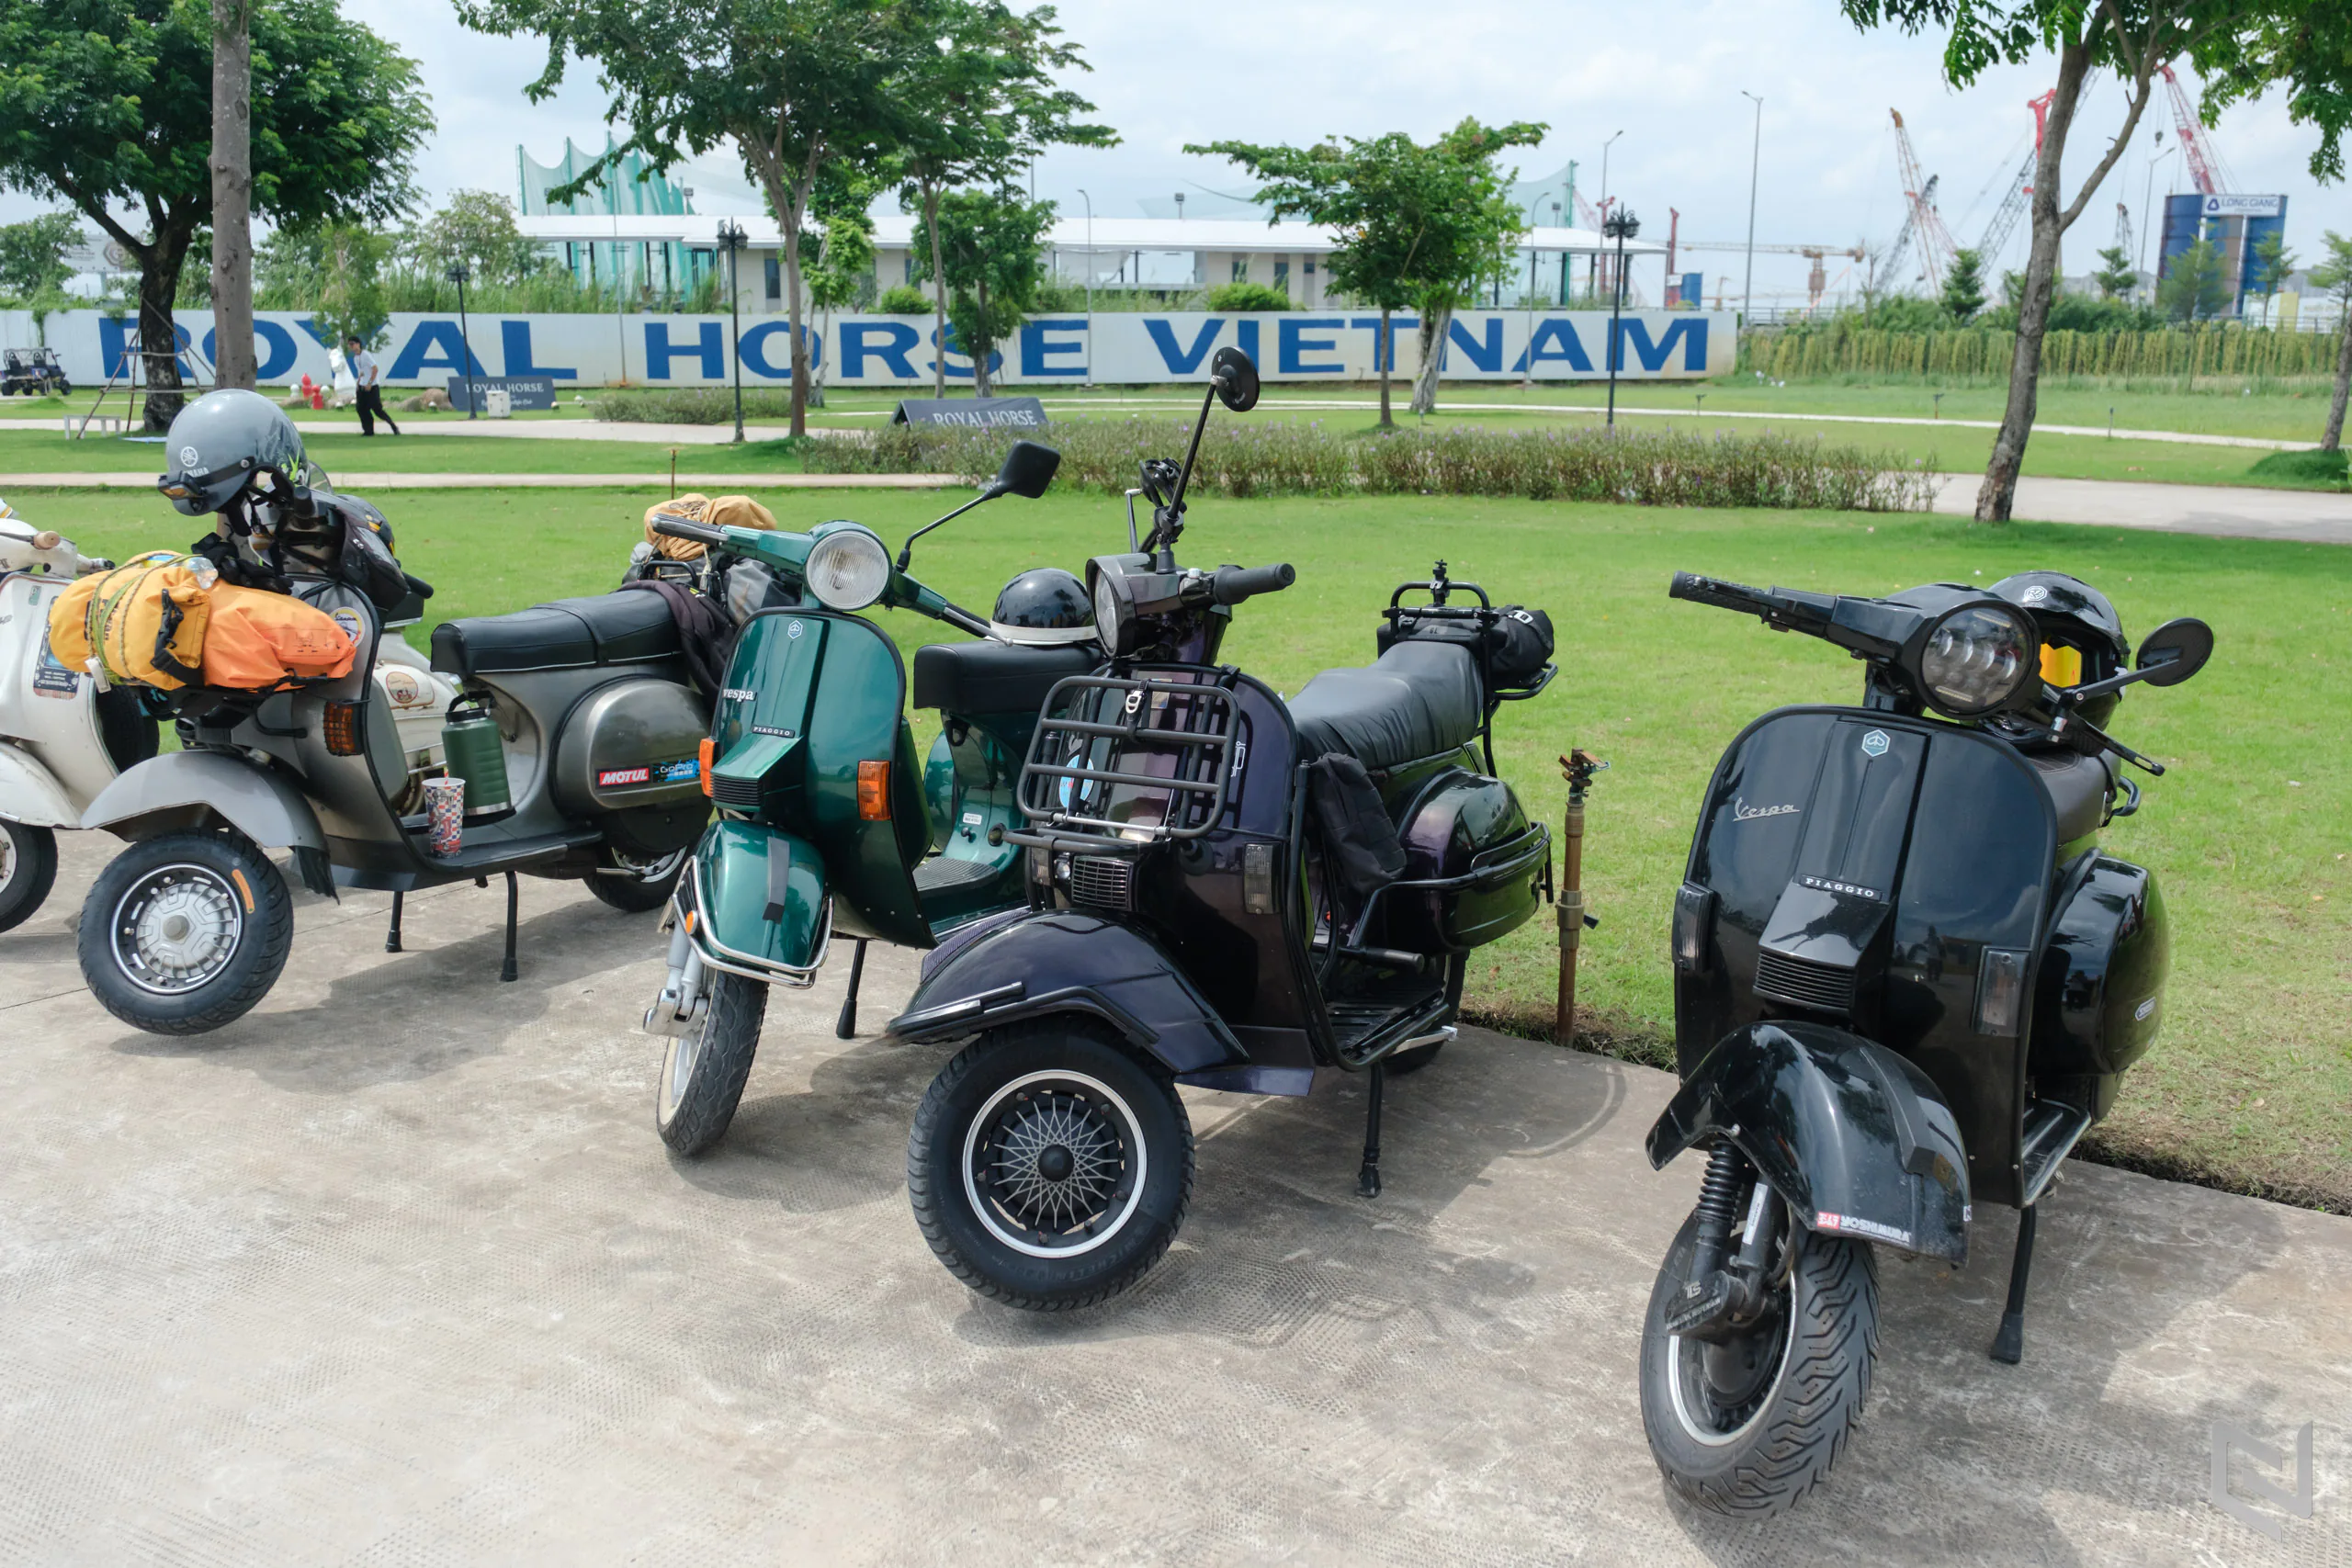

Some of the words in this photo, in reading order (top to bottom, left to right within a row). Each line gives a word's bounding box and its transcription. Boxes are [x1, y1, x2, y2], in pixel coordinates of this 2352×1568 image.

[645, 320, 1089, 380] HORSE
[1142, 318, 1709, 375] VIETNAM
[507, 382, 545, 393] HORSE
[988, 410, 1038, 426] HORSE
[722, 688, 755, 703] vespa
[752, 726, 791, 737] PIAGGIO
[601, 769, 649, 784] MOTUL
[660, 763, 695, 774] GoPro
[1733, 796, 1801, 822] Vespa
[1805, 876, 1875, 898] PIAGGIO
